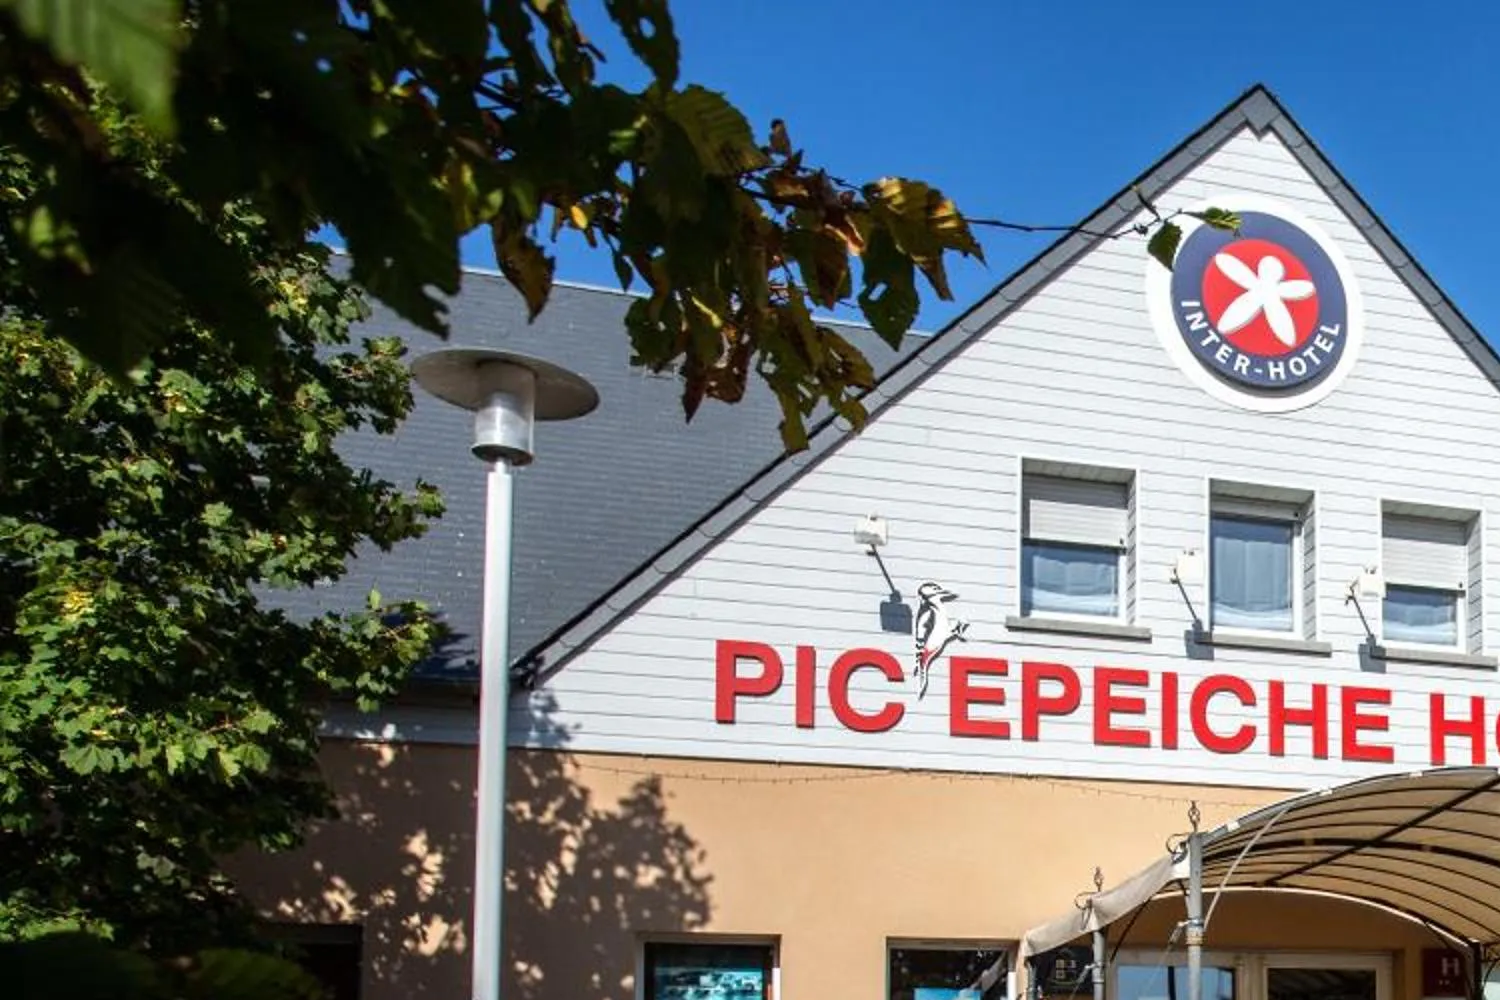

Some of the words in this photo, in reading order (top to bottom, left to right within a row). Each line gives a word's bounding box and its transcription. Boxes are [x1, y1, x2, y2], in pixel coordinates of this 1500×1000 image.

[1181, 300, 1340, 381] INTER-HOTEL
[715, 639, 906, 734] PIC
[949, 655, 1395, 764] EPEICHE
[1441, 957, 1460, 977] H
